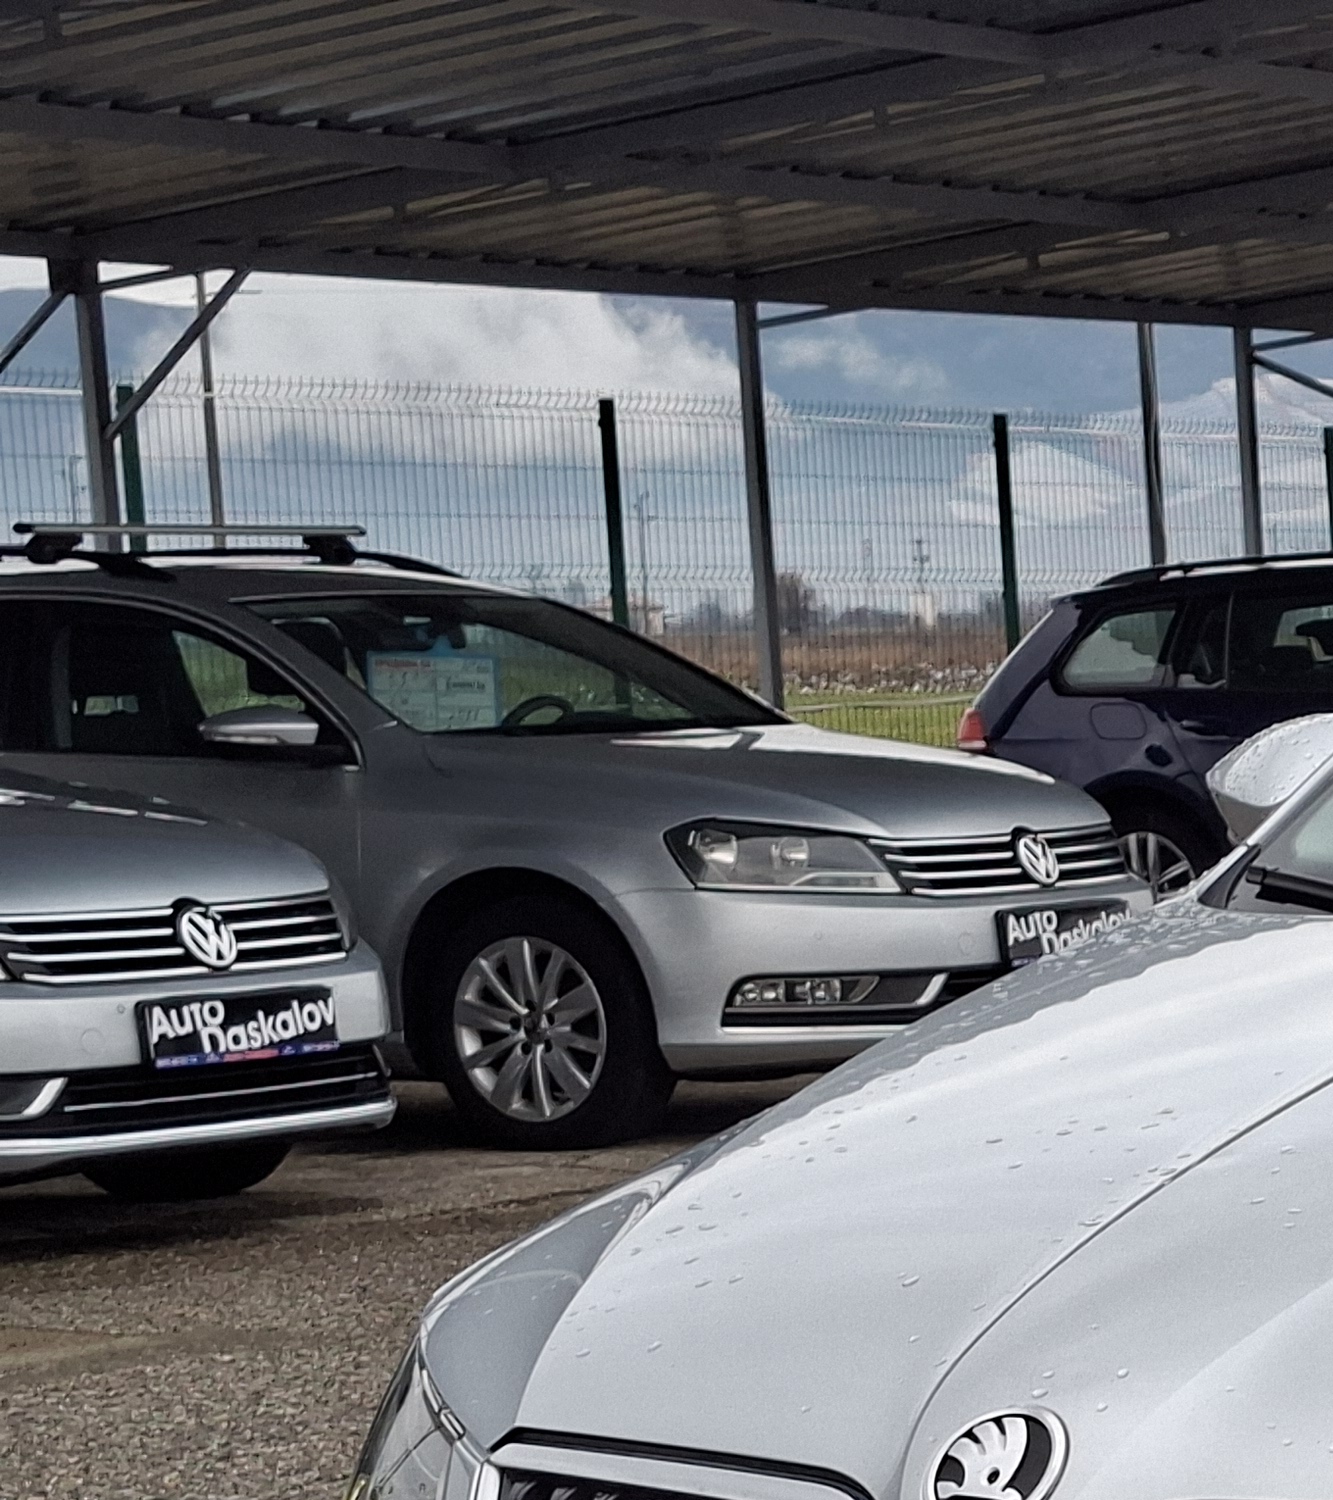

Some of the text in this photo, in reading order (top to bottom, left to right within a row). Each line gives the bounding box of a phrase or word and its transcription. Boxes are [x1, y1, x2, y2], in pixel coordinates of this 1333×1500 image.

[1007, 910, 1058, 946] Auto
[152, 1000, 225, 1044] Auto
[200, 997, 335, 1053] Daskalov
